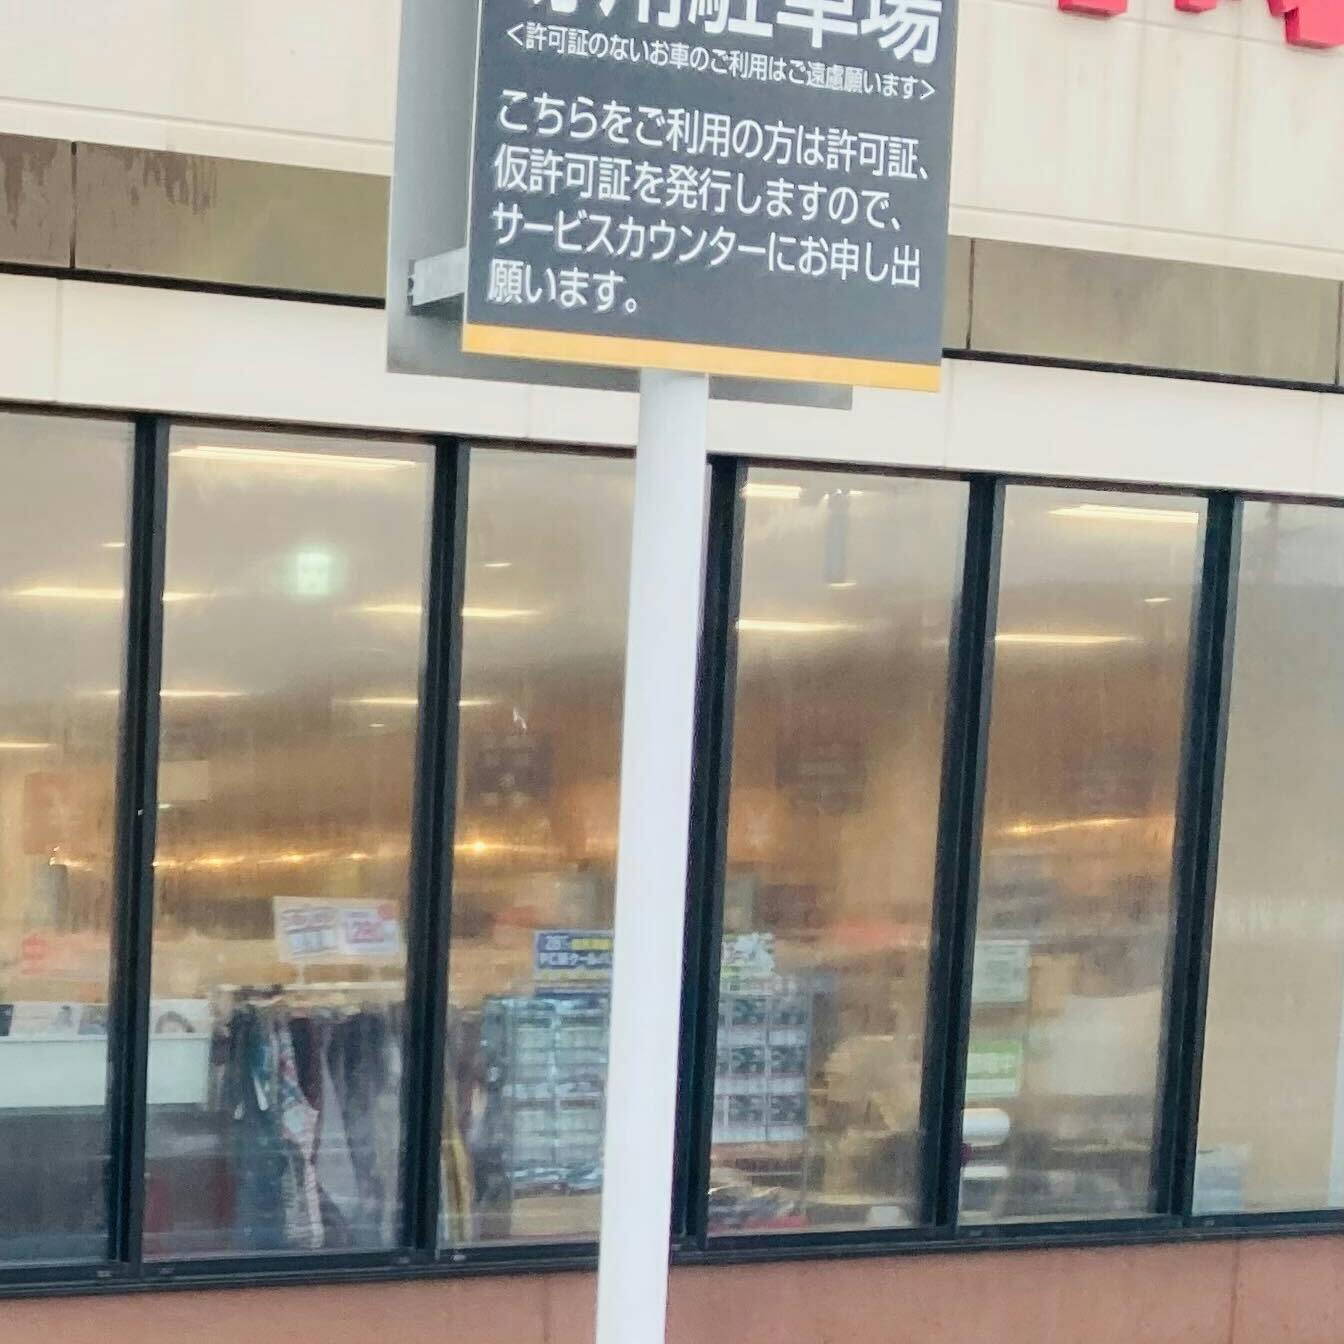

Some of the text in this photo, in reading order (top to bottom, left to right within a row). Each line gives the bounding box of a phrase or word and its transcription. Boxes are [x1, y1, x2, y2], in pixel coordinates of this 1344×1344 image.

[498, 89, 930, 182] こちらをご利用の方は許可証、
[493, 143, 906, 233] 仮許可証を発行しますので、
[486, 257, 640, 315] 願います。
[491, 203, 923, 291] サービスカウンターにお申し出
